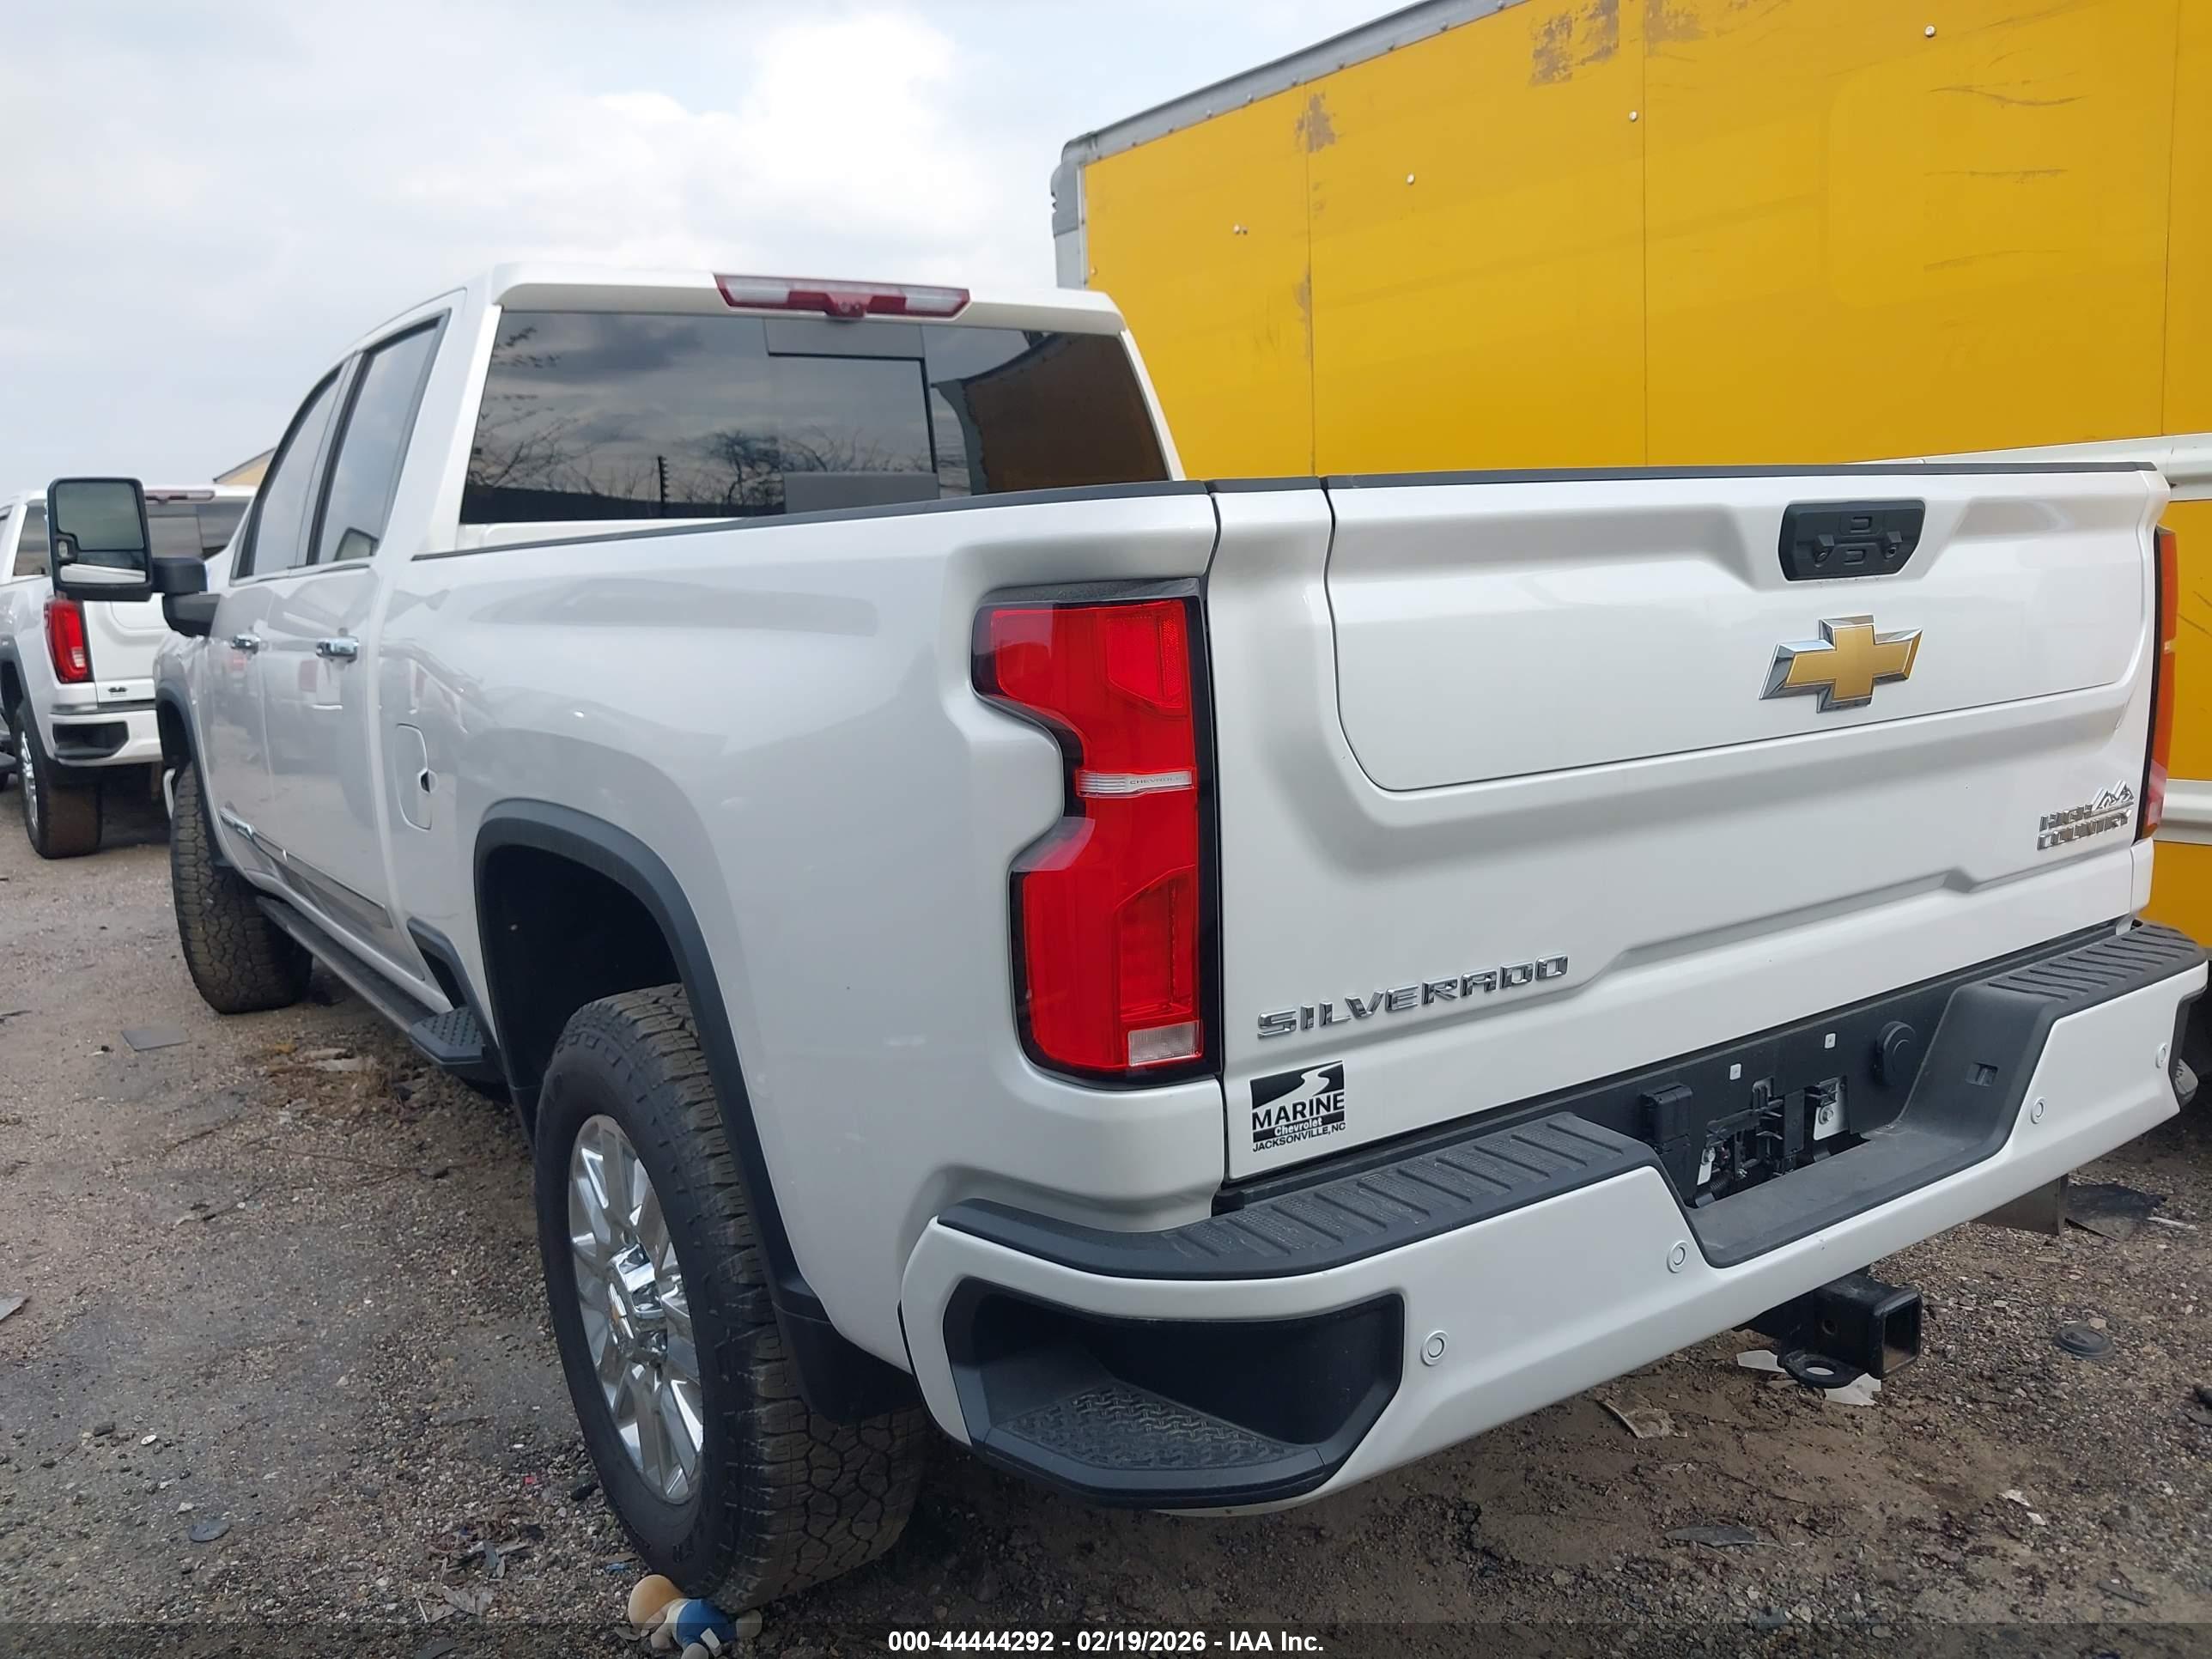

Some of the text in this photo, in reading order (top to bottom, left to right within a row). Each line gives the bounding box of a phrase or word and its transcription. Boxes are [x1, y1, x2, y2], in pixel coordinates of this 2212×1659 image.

[1129, 775, 1186, 785] CHEVROLE
[2037, 809, 2132, 850] COUNTRY
[2039, 804, 2094, 831] HIGH
[1257, 954, 1569, 1039] SILVERADO
[1252, 1091, 1345, 1131] MARINE
[1274, 1117, 1323, 1137] Chevrolet
